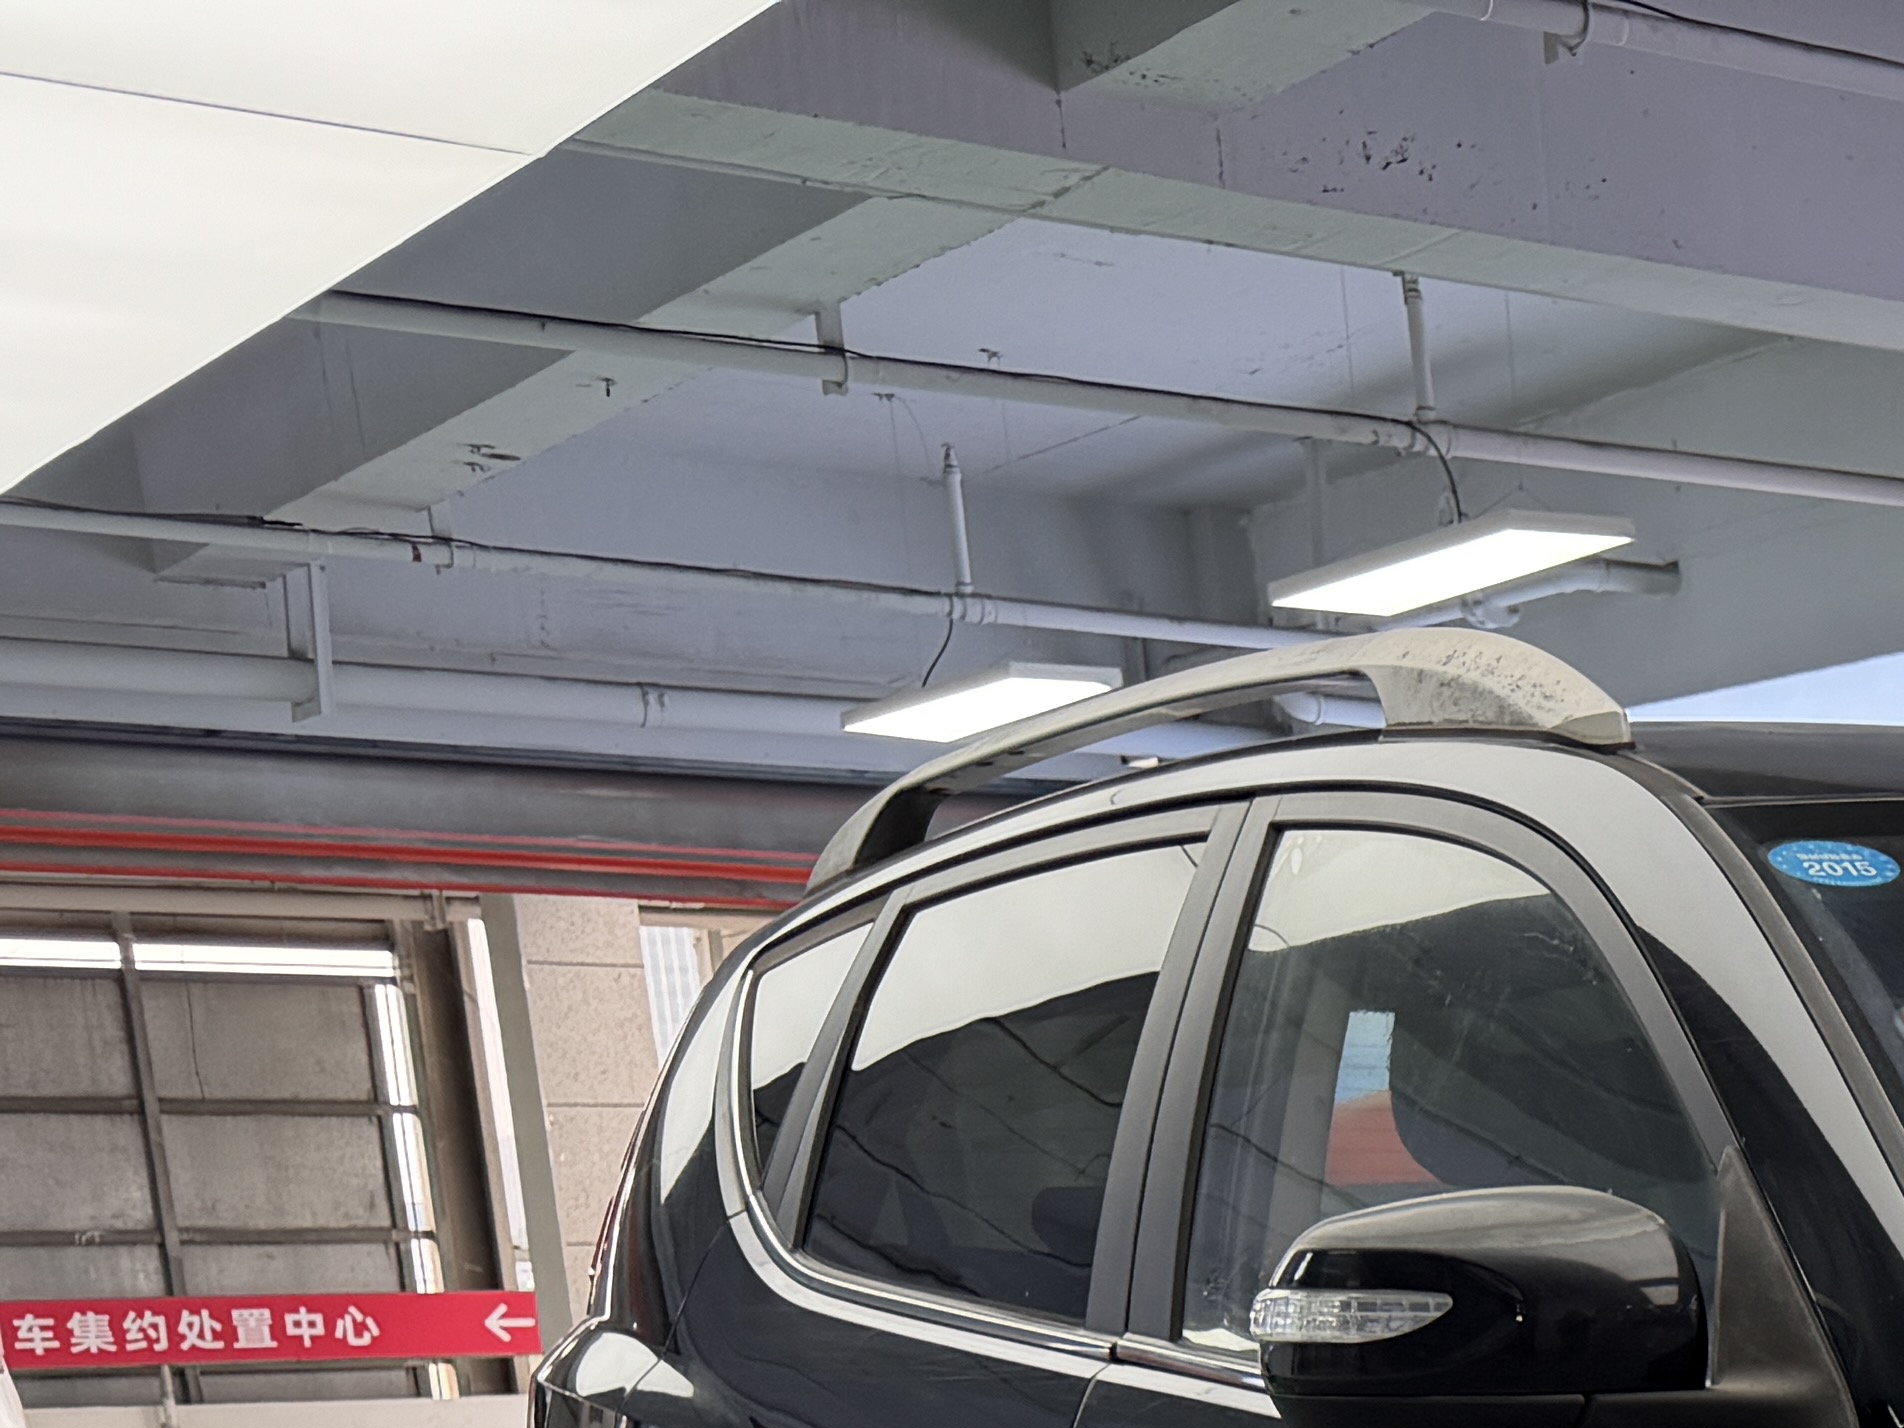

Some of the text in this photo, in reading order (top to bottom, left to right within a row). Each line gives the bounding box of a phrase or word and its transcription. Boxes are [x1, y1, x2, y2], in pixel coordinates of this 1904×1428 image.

[1802, 860, 1878, 877] 2015
[13, 1305, 380, 1356] 车集约处置中心
